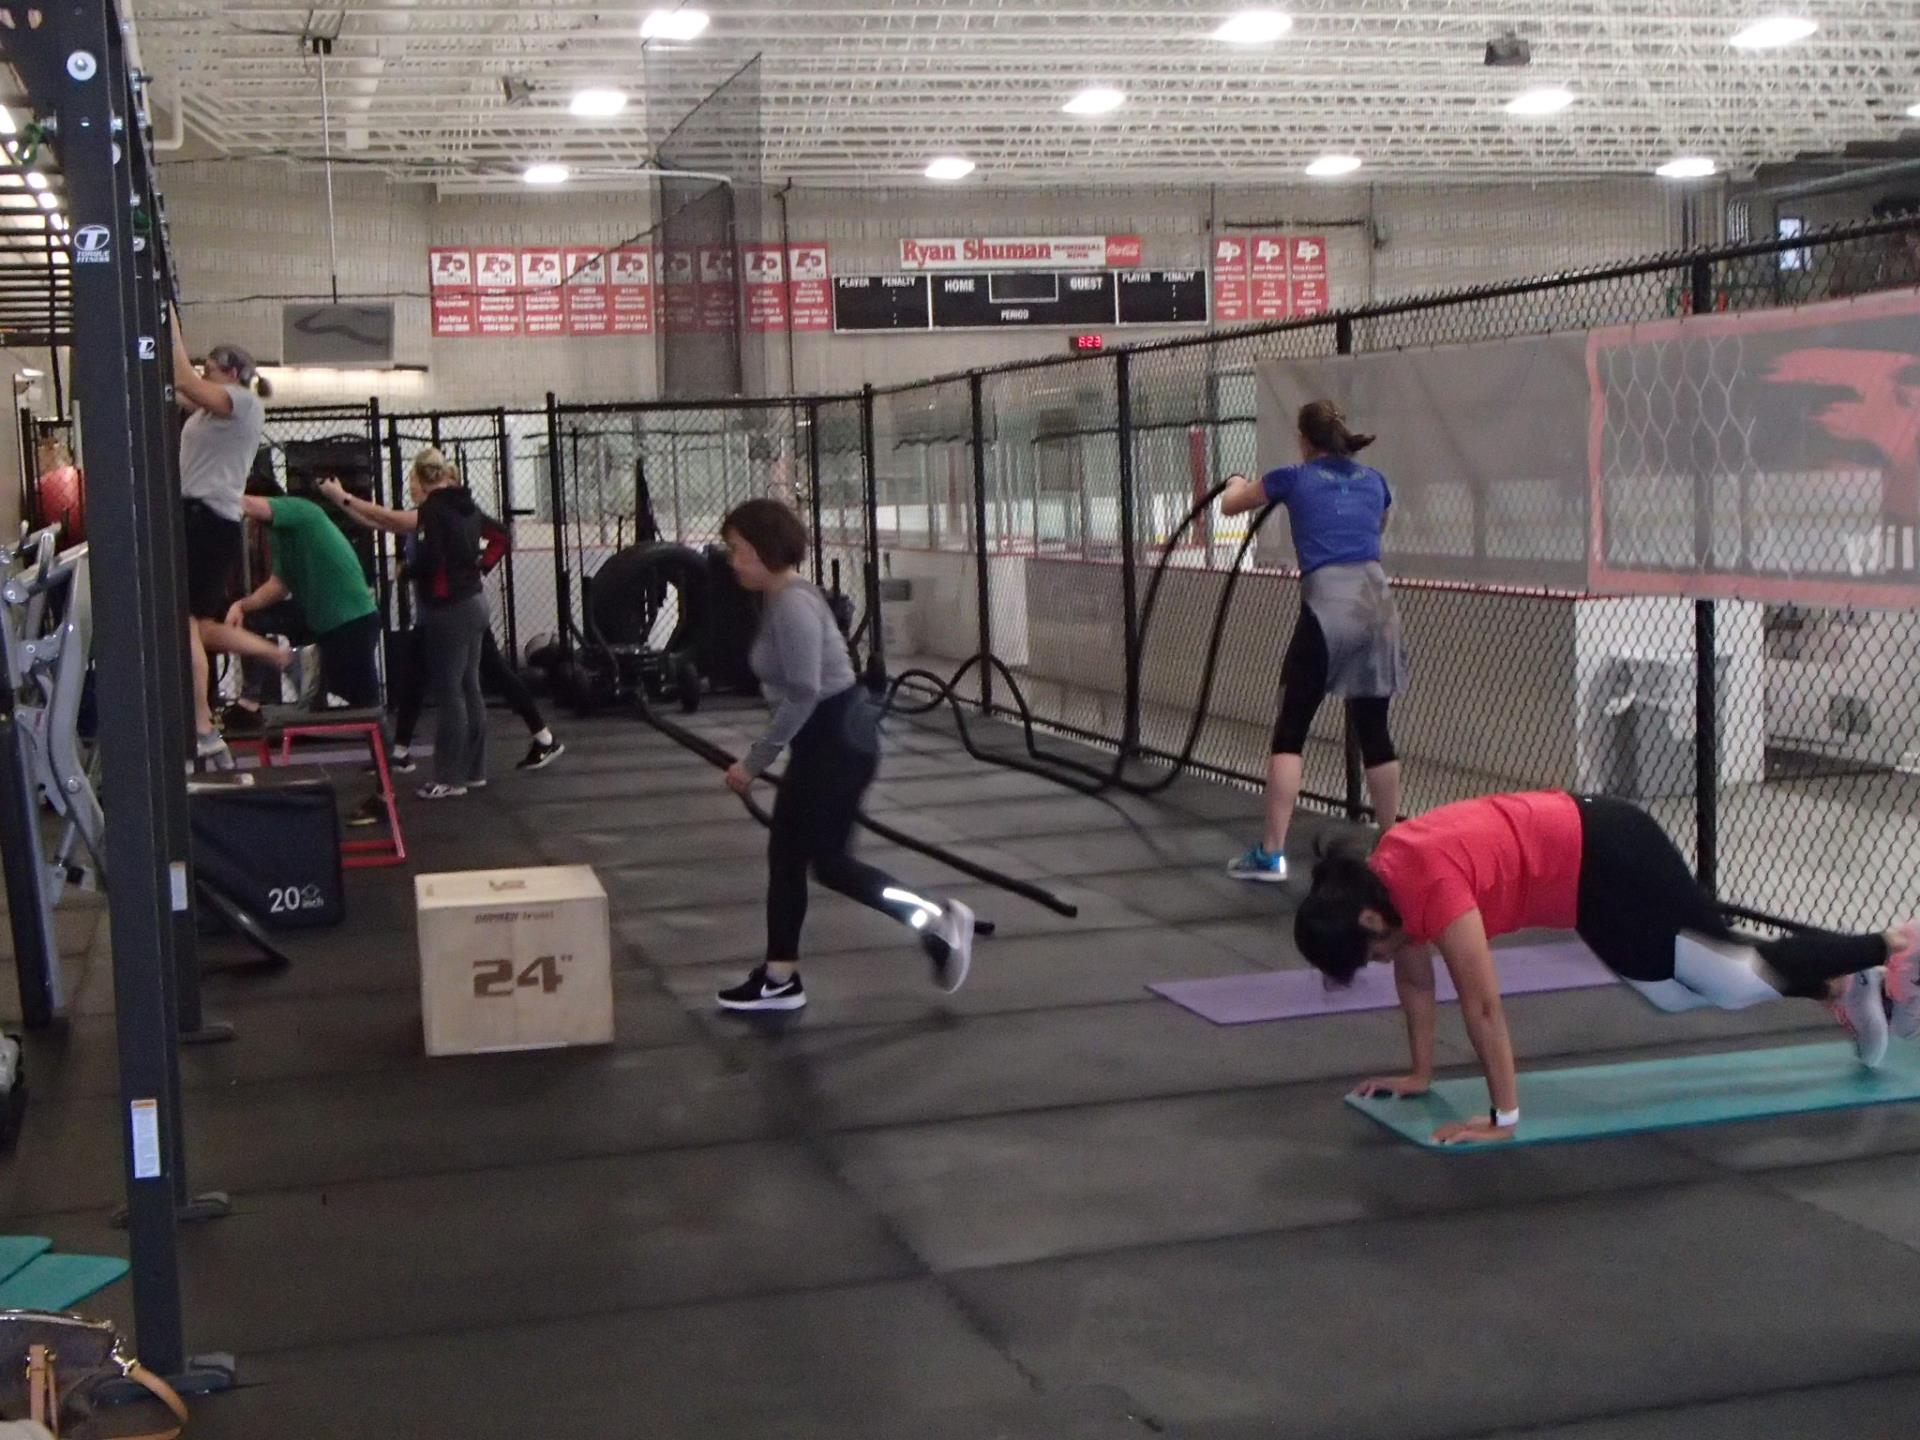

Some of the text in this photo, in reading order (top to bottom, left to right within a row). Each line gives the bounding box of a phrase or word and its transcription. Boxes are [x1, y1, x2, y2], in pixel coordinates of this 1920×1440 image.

[903, 237, 1052, 269] Ryan Shuman
[840, 277, 916, 287] PLAYER PENALTY
[1070, 277, 1103, 290] GUEST
[1122, 272, 1195, 283] PLAYER PENALTY
[944, 279, 975, 292] HOME
[1001, 309, 1029, 320] PERIOD
[268, 886, 300, 913] 20
